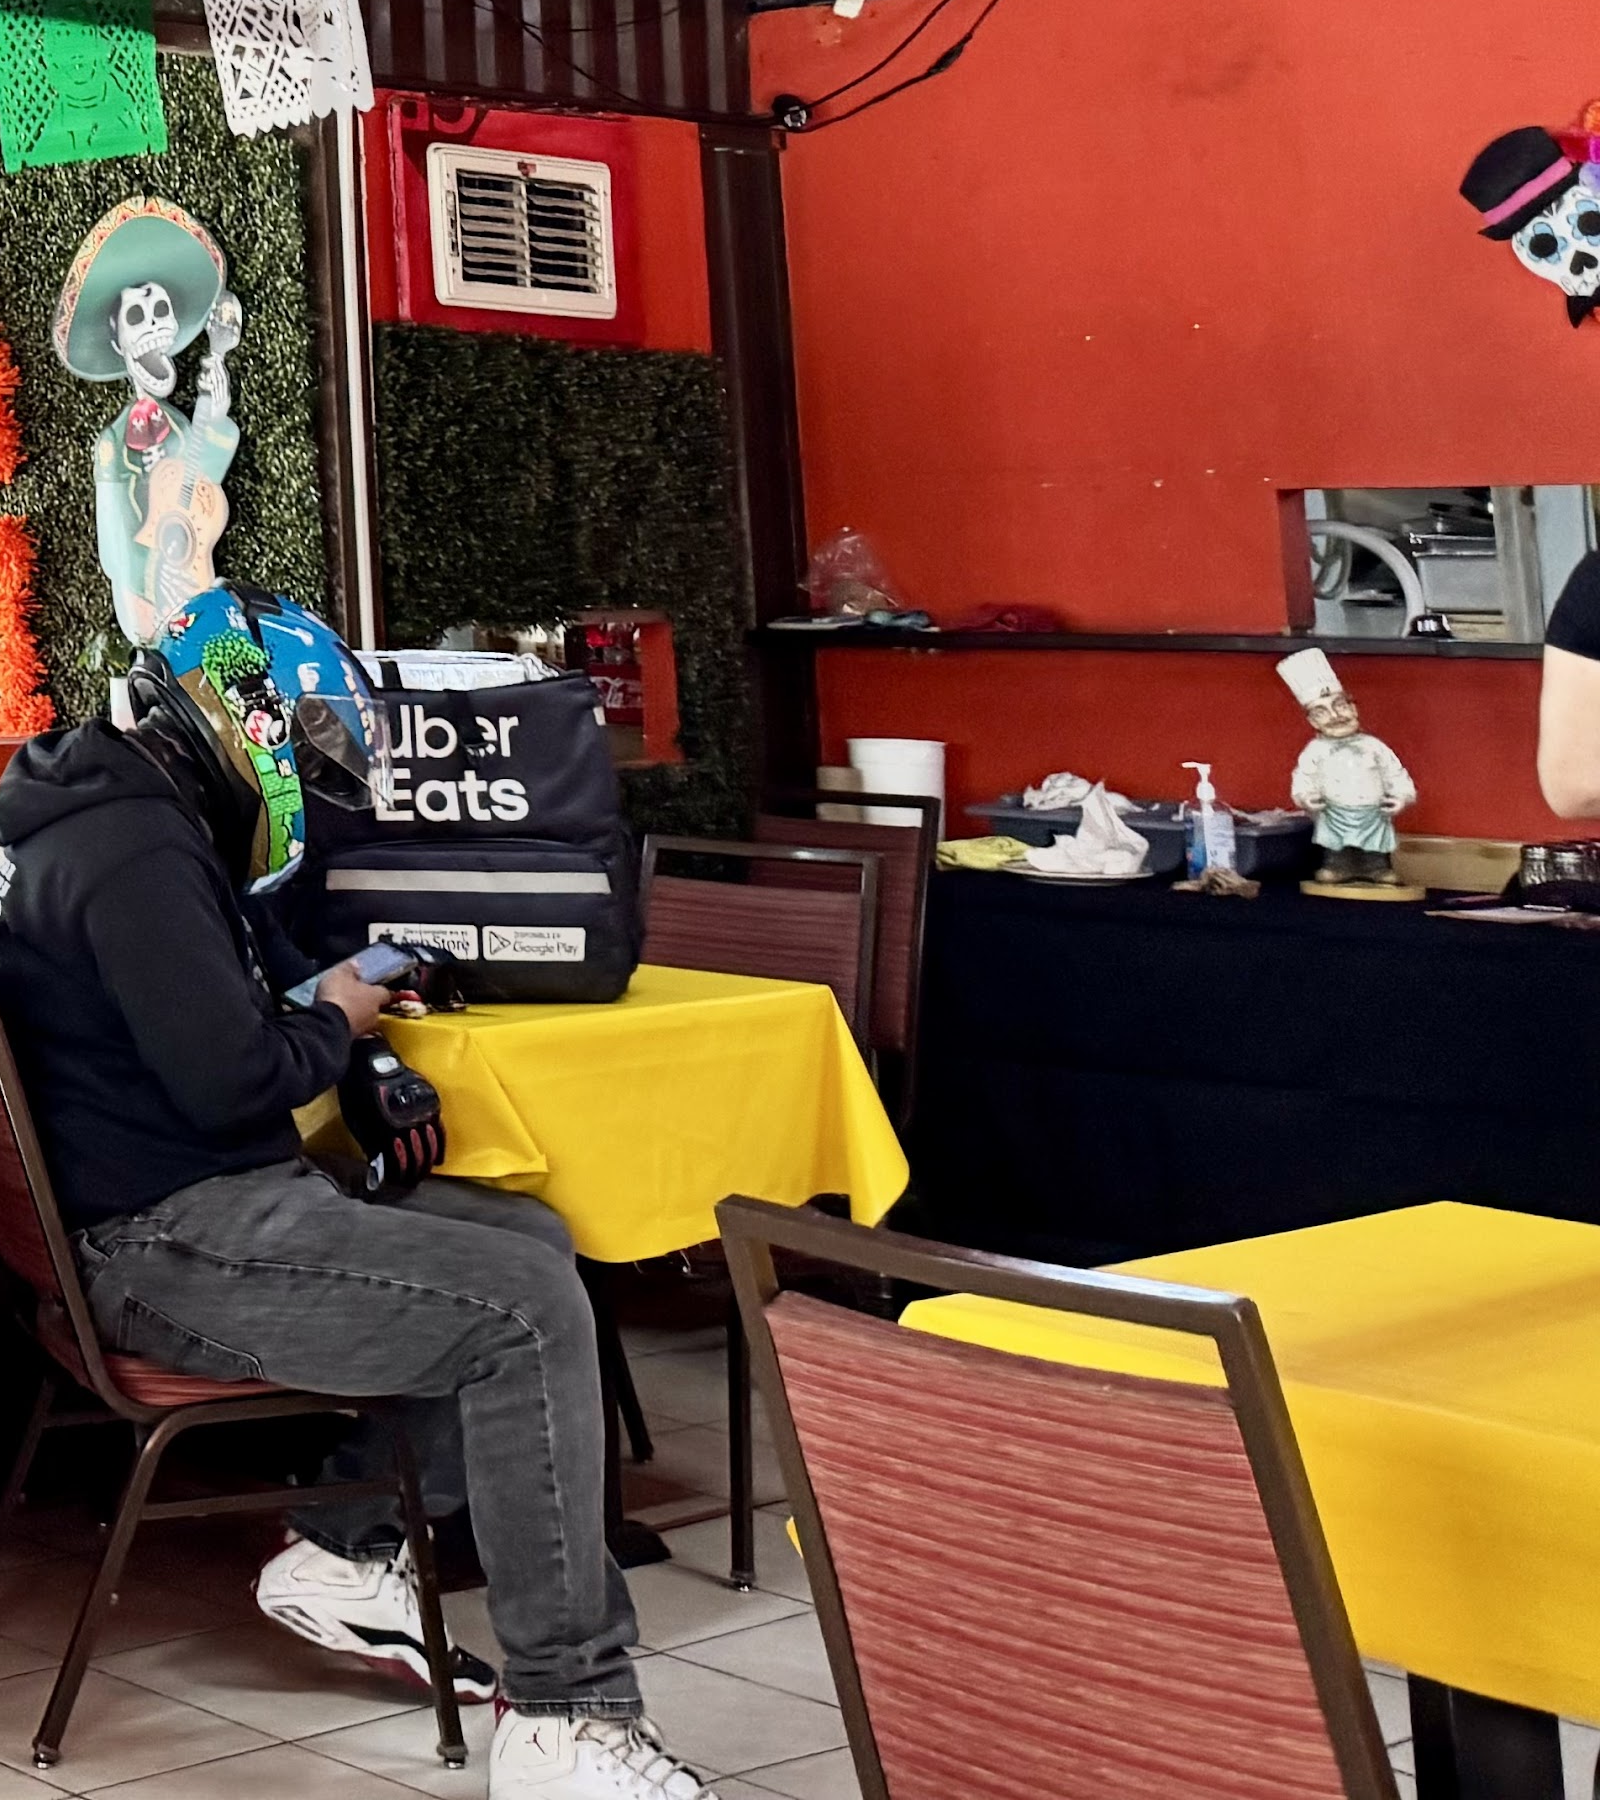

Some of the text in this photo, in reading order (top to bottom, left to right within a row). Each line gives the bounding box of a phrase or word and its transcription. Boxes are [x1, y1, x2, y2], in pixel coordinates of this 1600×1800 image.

[374, 767, 530, 822] Eats
[513, 941, 578, 955] Google Play
